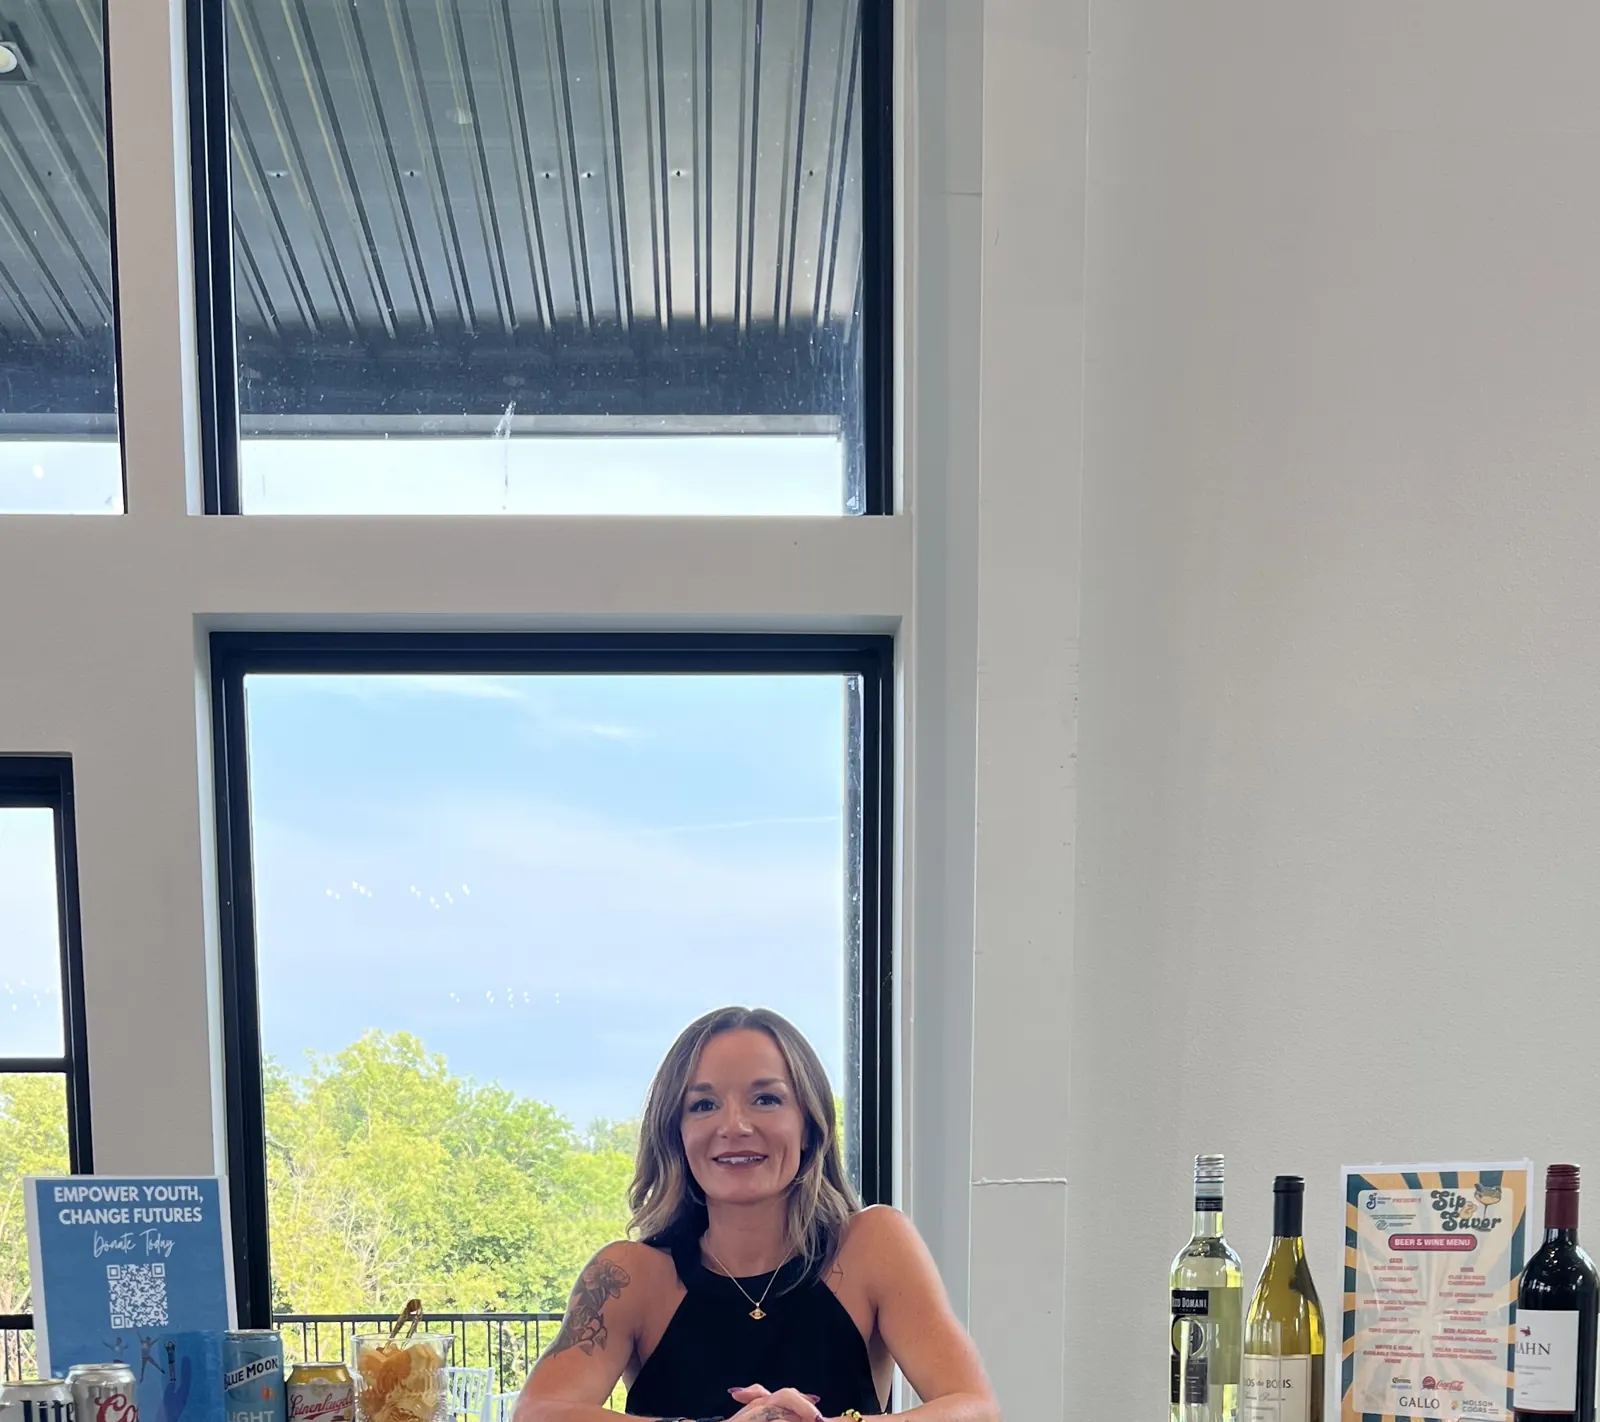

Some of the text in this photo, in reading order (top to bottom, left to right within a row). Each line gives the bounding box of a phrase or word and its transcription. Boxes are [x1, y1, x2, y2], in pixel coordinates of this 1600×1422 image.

[54, 1185, 203, 1203] EMPOWER YOUTH,
[1431, 1190, 1466, 1212] Sip
[59, 1207, 203, 1224] CHANGE FUTURES
[1440, 1210, 1502, 1232] Savor
[93, 1228, 175, 1258] Donate Today
[1394, 1238, 1471, 1246] BEER & WINE MENU
[246, 1357, 278, 1379] MOON
[1399, 1396, 1440, 1409] GALLO
